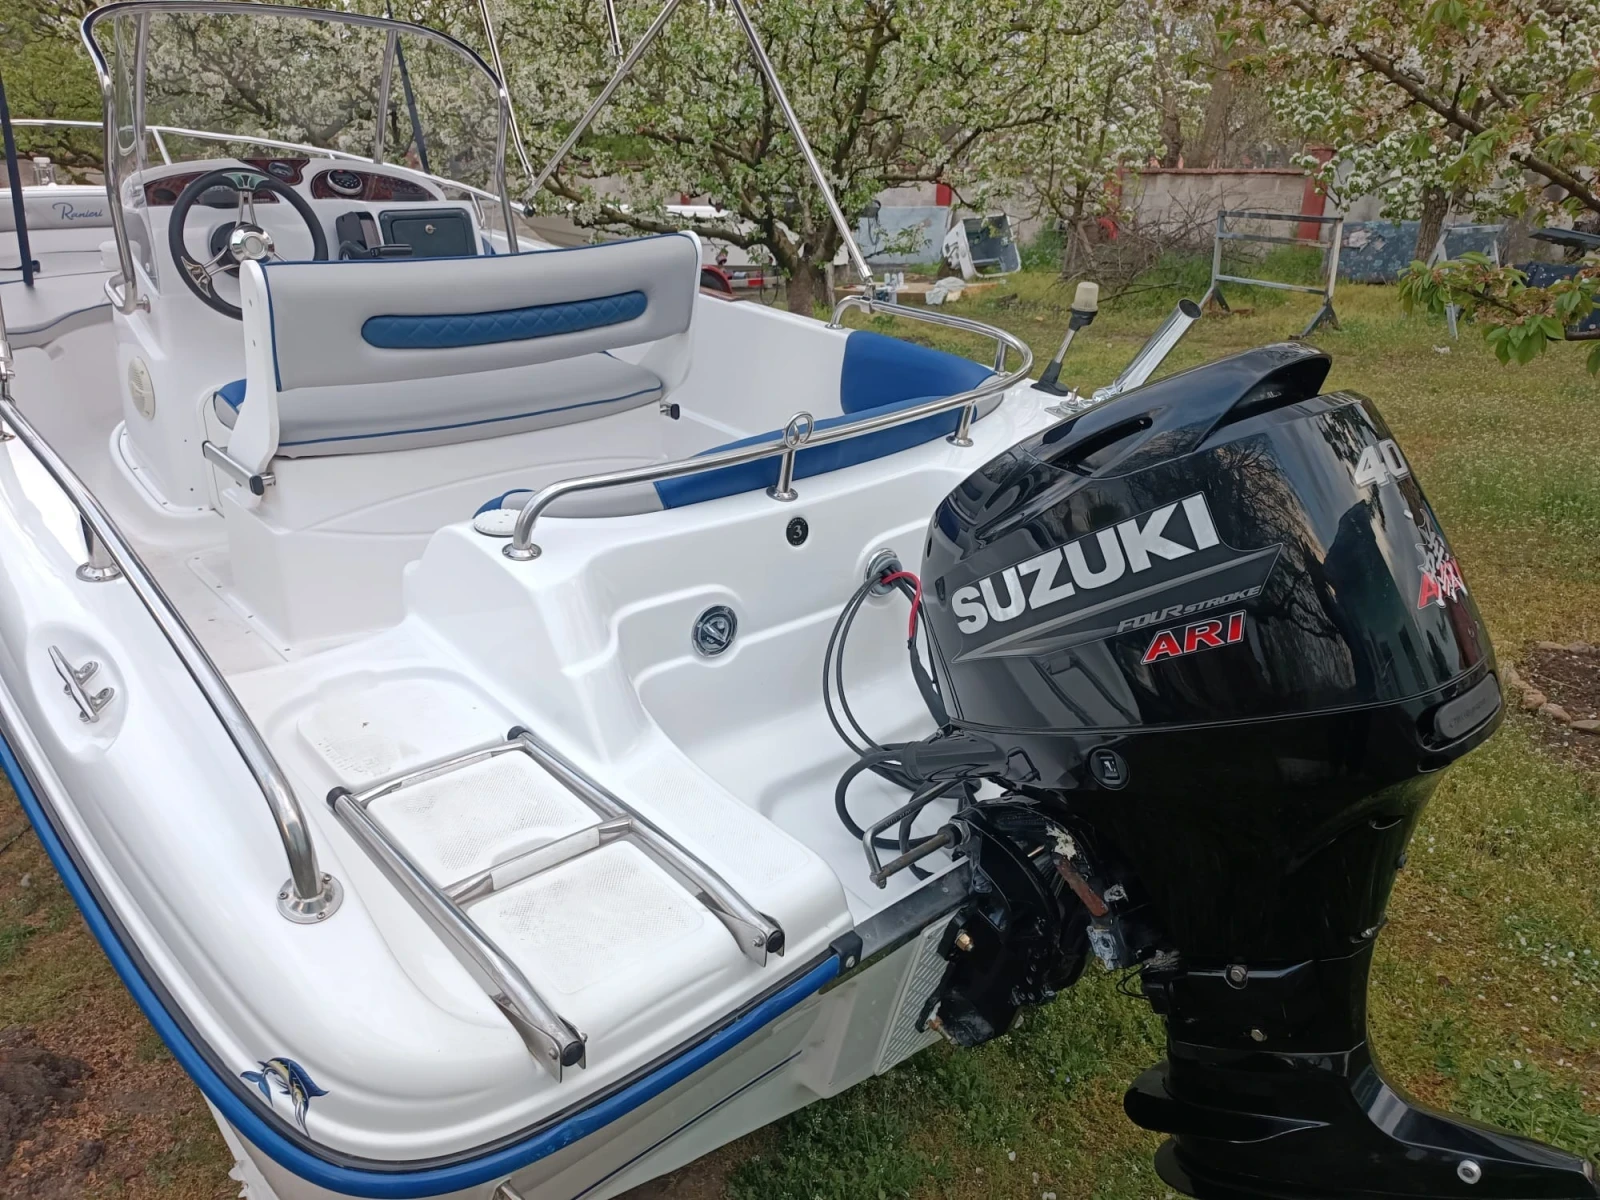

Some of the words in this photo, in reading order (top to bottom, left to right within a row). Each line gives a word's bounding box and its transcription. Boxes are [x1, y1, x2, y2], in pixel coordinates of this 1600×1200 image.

[52, 202, 103, 220] Ranieri
[1354, 438, 1411, 488] 40
[793, 524, 803, 539] 3
[951, 493, 1220, 635] SUZUKI
[1116, 603, 1185, 633] FOUR
[1183, 585, 1262, 615] STROKE
[1142, 610, 1246, 664] ARI
